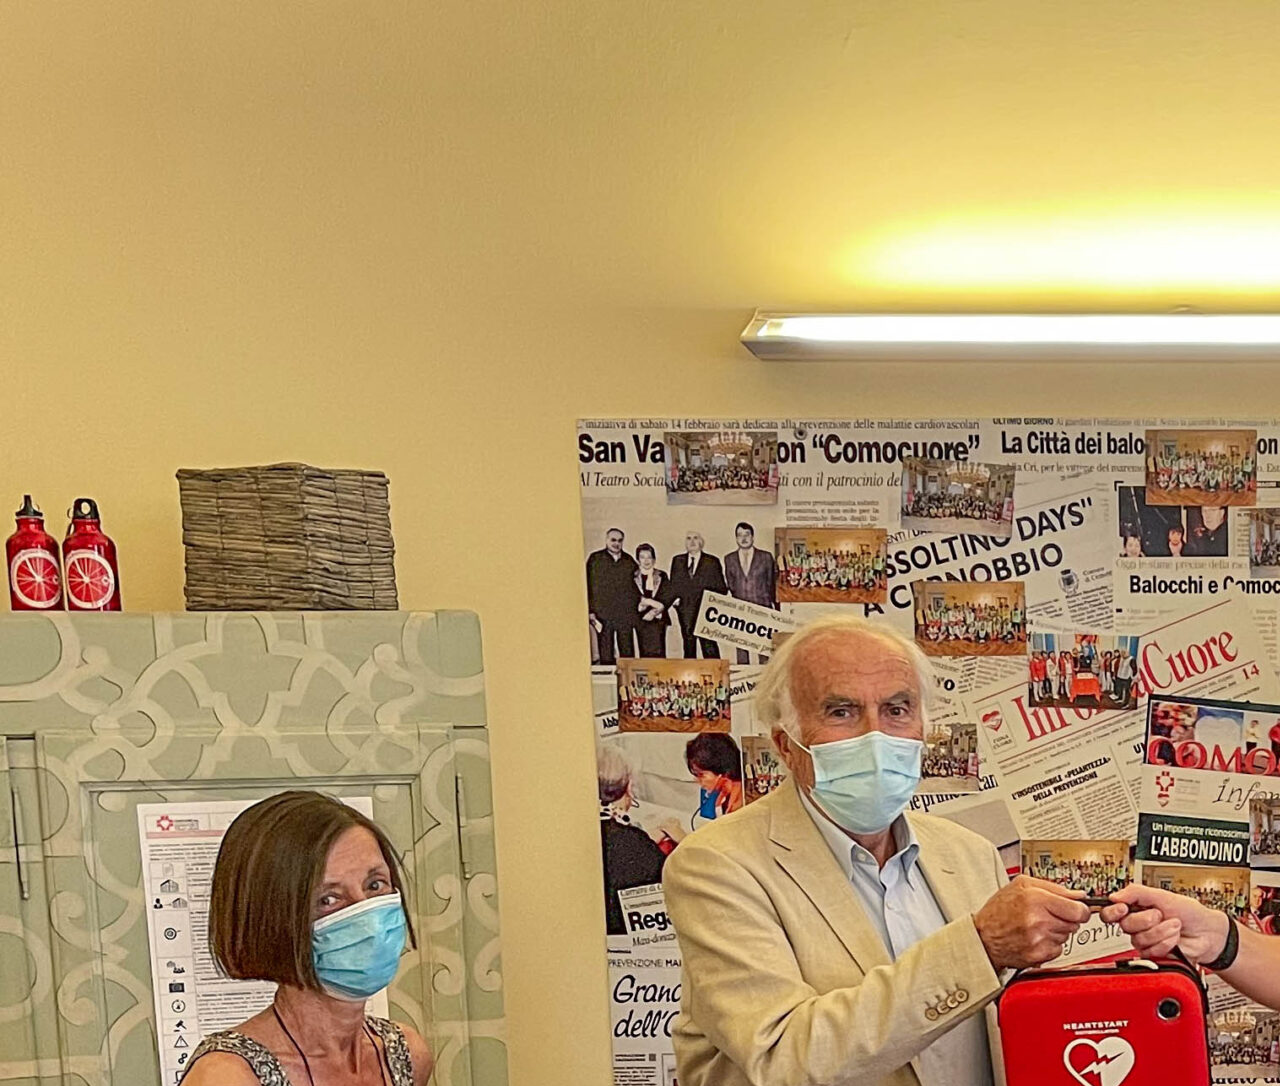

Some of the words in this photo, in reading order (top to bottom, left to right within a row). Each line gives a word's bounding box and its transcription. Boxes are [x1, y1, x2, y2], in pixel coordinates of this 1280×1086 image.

[640, 419, 668, 429] sabato
[671, 419, 682, 429] 14
[684, 419, 720, 429] febbraio
[742, 419, 779, 429] dedicata
[853, 419, 875, 429] delle
[877, 419, 912, 429] malattie
[914, 419, 980, 429] cardiovascolari
[578, 433, 626, 463] San
[632, 434, 665, 463] Va
[777, 441, 806, 463] on
[1001, 431, 1022, 454] La
[1027, 431, 1070, 454] Città
[1075, 432, 1102, 454] dei
[1106, 432, 1146, 455] balo
[1257, 438, 1278, 454] on
[1041, 464, 1054, 475] per
[1111, 464, 1145, 473] maremo
[594, 472, 630, 487] Teatro
[633, 472, 666, 487] Socia
[792, 475, 812, 487] con
[816, 472, 824, 487] il
[826, 472, 884, 491] patrocinio
[1129, 575, 1203, 594] Balocchi
[1208, 580, 1218, 594] e
[1243, 664, 1260, 680] 14
[602, 716, 619, 730] Abb
[1032, 790, 1053, 802] DELLA
[1054, 771, 1098, 794] PREVENZIONE
[1151, 822, 1163, 832] Un
[1163, 823, 1204, 836] importante
[1150, 835, 1243, 864] L'ABBONDINO
[627, 911, 672, 932] Reg
[613, 974, 682, 1004] Gran
[613, 1010, 680, 1039] dell'
[1062, 1020, 1129, 1030] HEARTSTART
